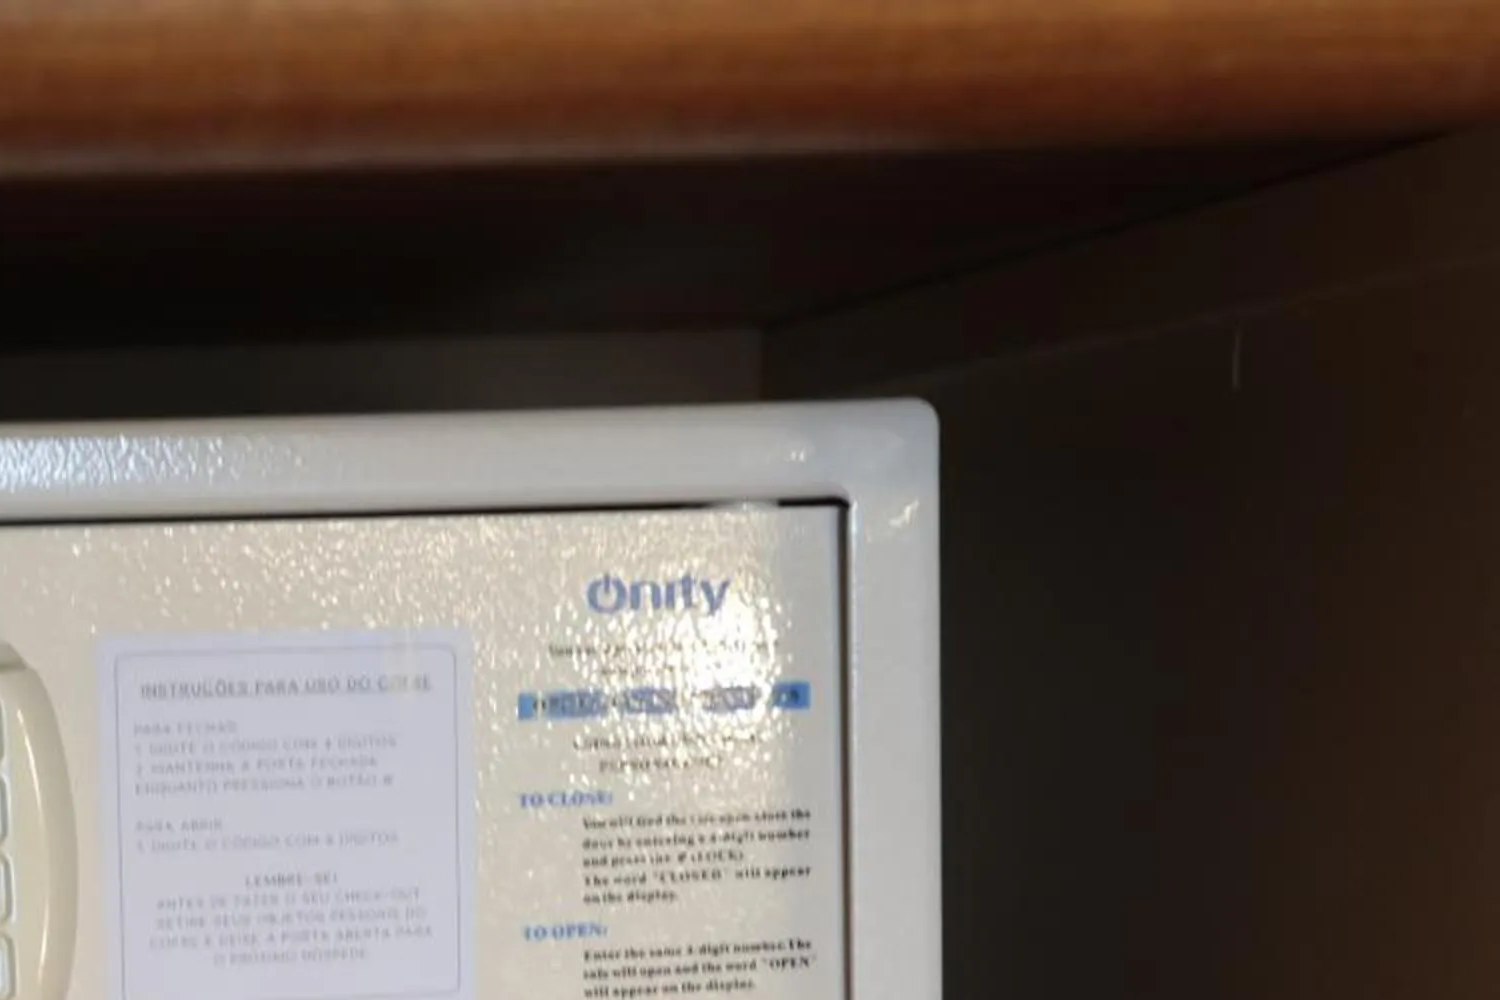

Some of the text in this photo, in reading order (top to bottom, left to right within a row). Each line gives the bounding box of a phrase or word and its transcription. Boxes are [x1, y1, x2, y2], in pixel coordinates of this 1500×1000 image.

[587, 572, 731, 616] Onity
[255, 677, 300, 698] PARA
[304, 676, 341, 696] USO
[347, 675, 372, 694] DO
[520, 792, 545, 808] TO
[790, 807, 811, 821] the
[758, 827, 810, 842] number
[522, 924, 548, 942] TO
[624, 945, 646, 960] the
[612, 965, 637, 979] will
[639, 966, 672, 979] open
[674, 962, 699, 976] and
[701, 960, 722, 974] the
[725, 958, 757, 973] word
[584, 985, 610, 999] will
[681, 980, 701, 995] the
